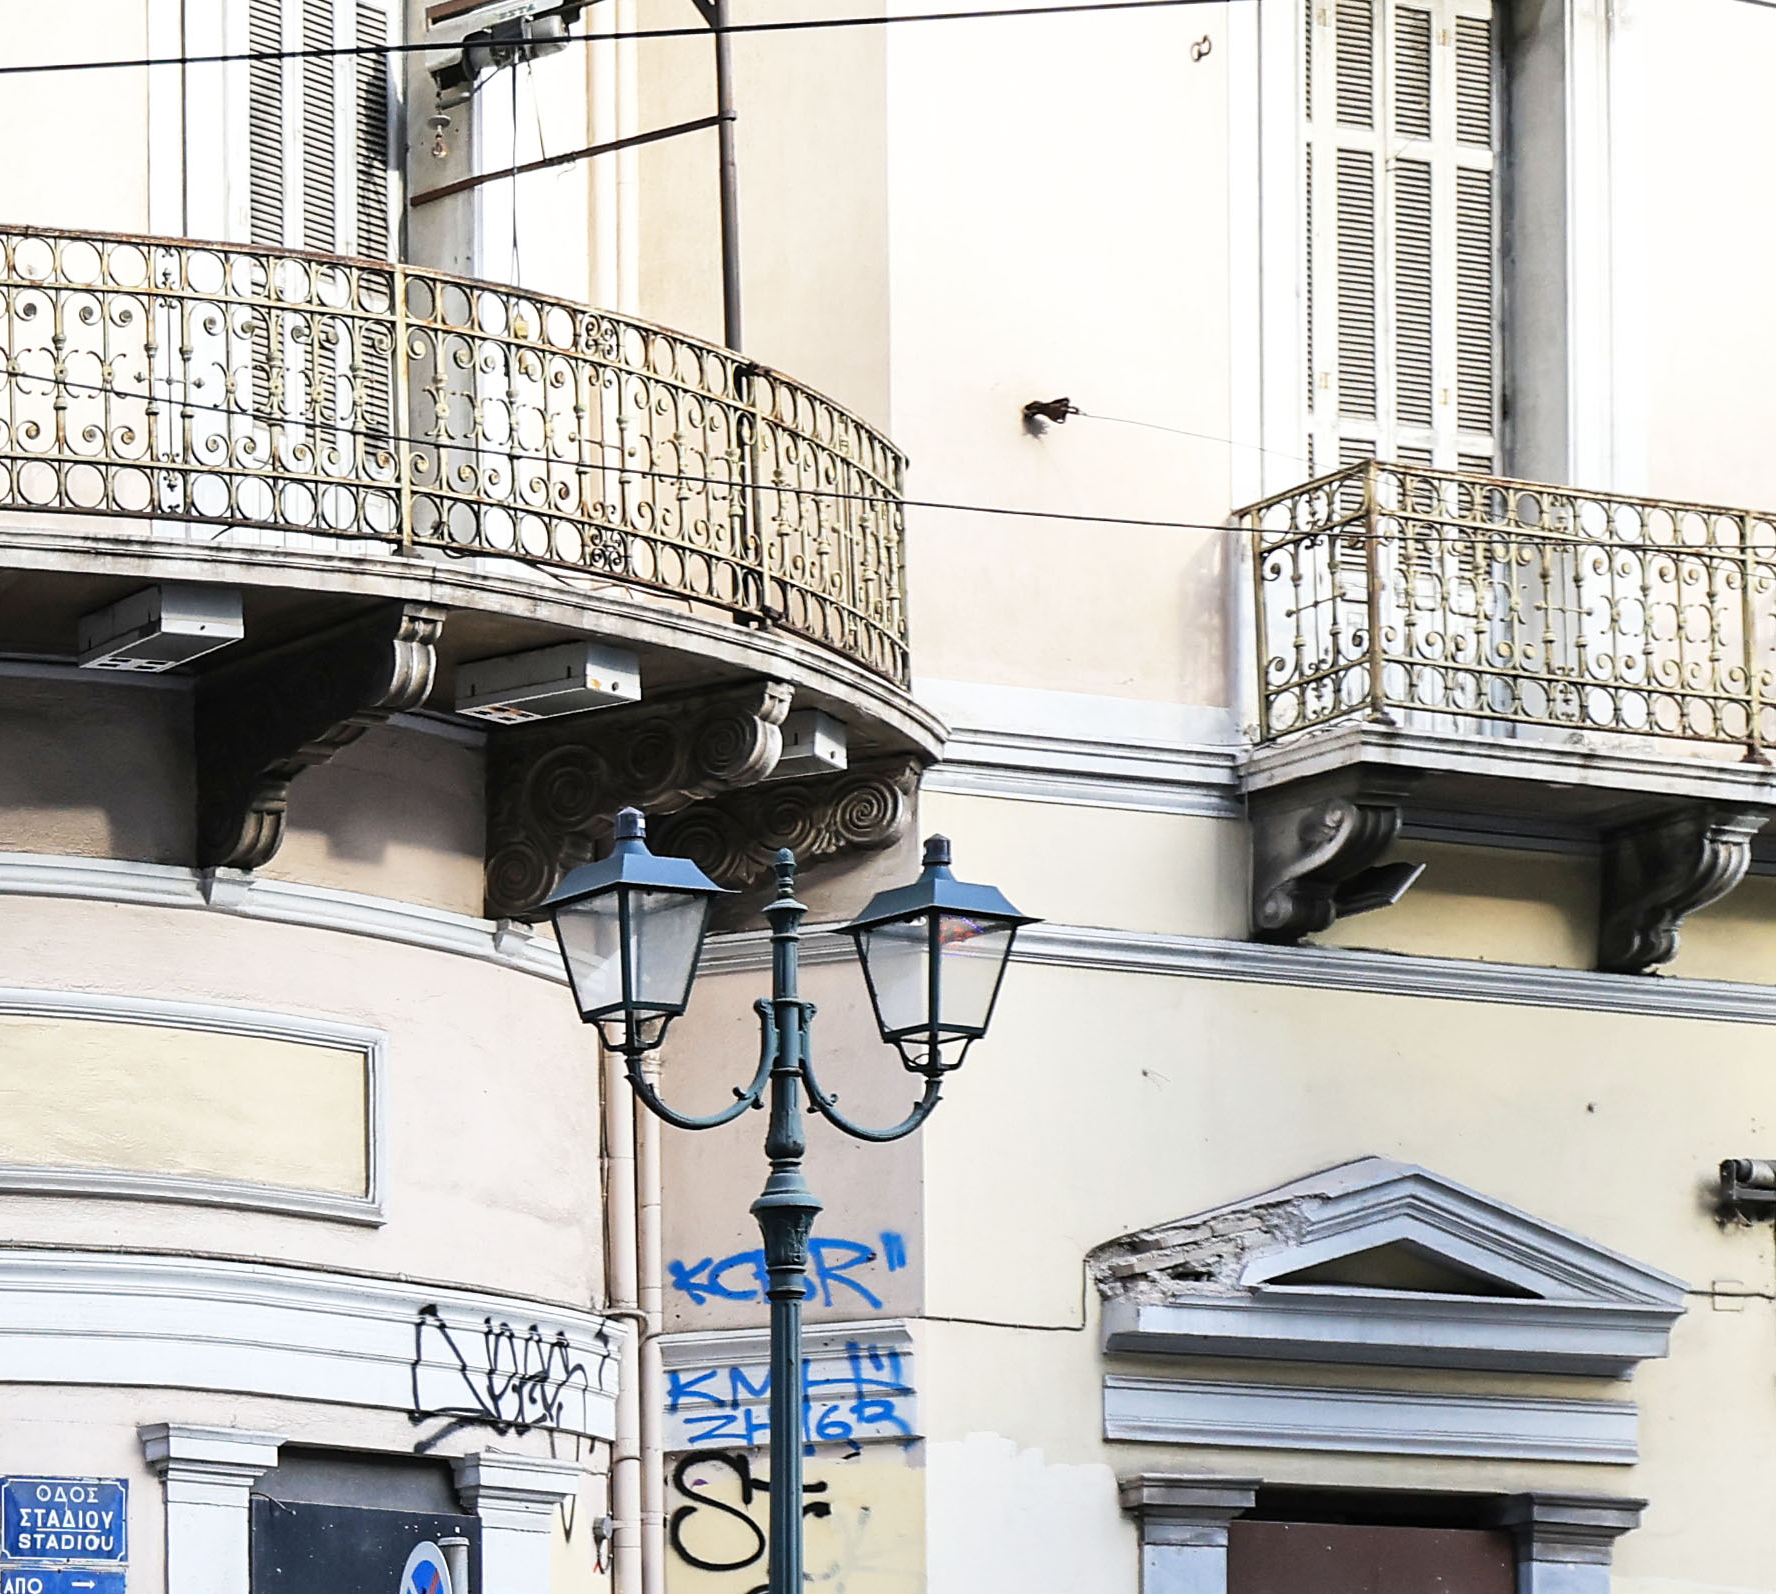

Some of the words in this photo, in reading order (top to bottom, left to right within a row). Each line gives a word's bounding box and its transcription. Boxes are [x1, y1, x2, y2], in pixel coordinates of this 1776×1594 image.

[36, 1484, 99, 1503] ΟΔΟΣ
[19, 1508, 114, 1529] ΣΤΑΔΙΟΥ
[18, 1533, 114, 1551] STADIOU
[3, 1577, 43, 1594] ΑΠΟ
